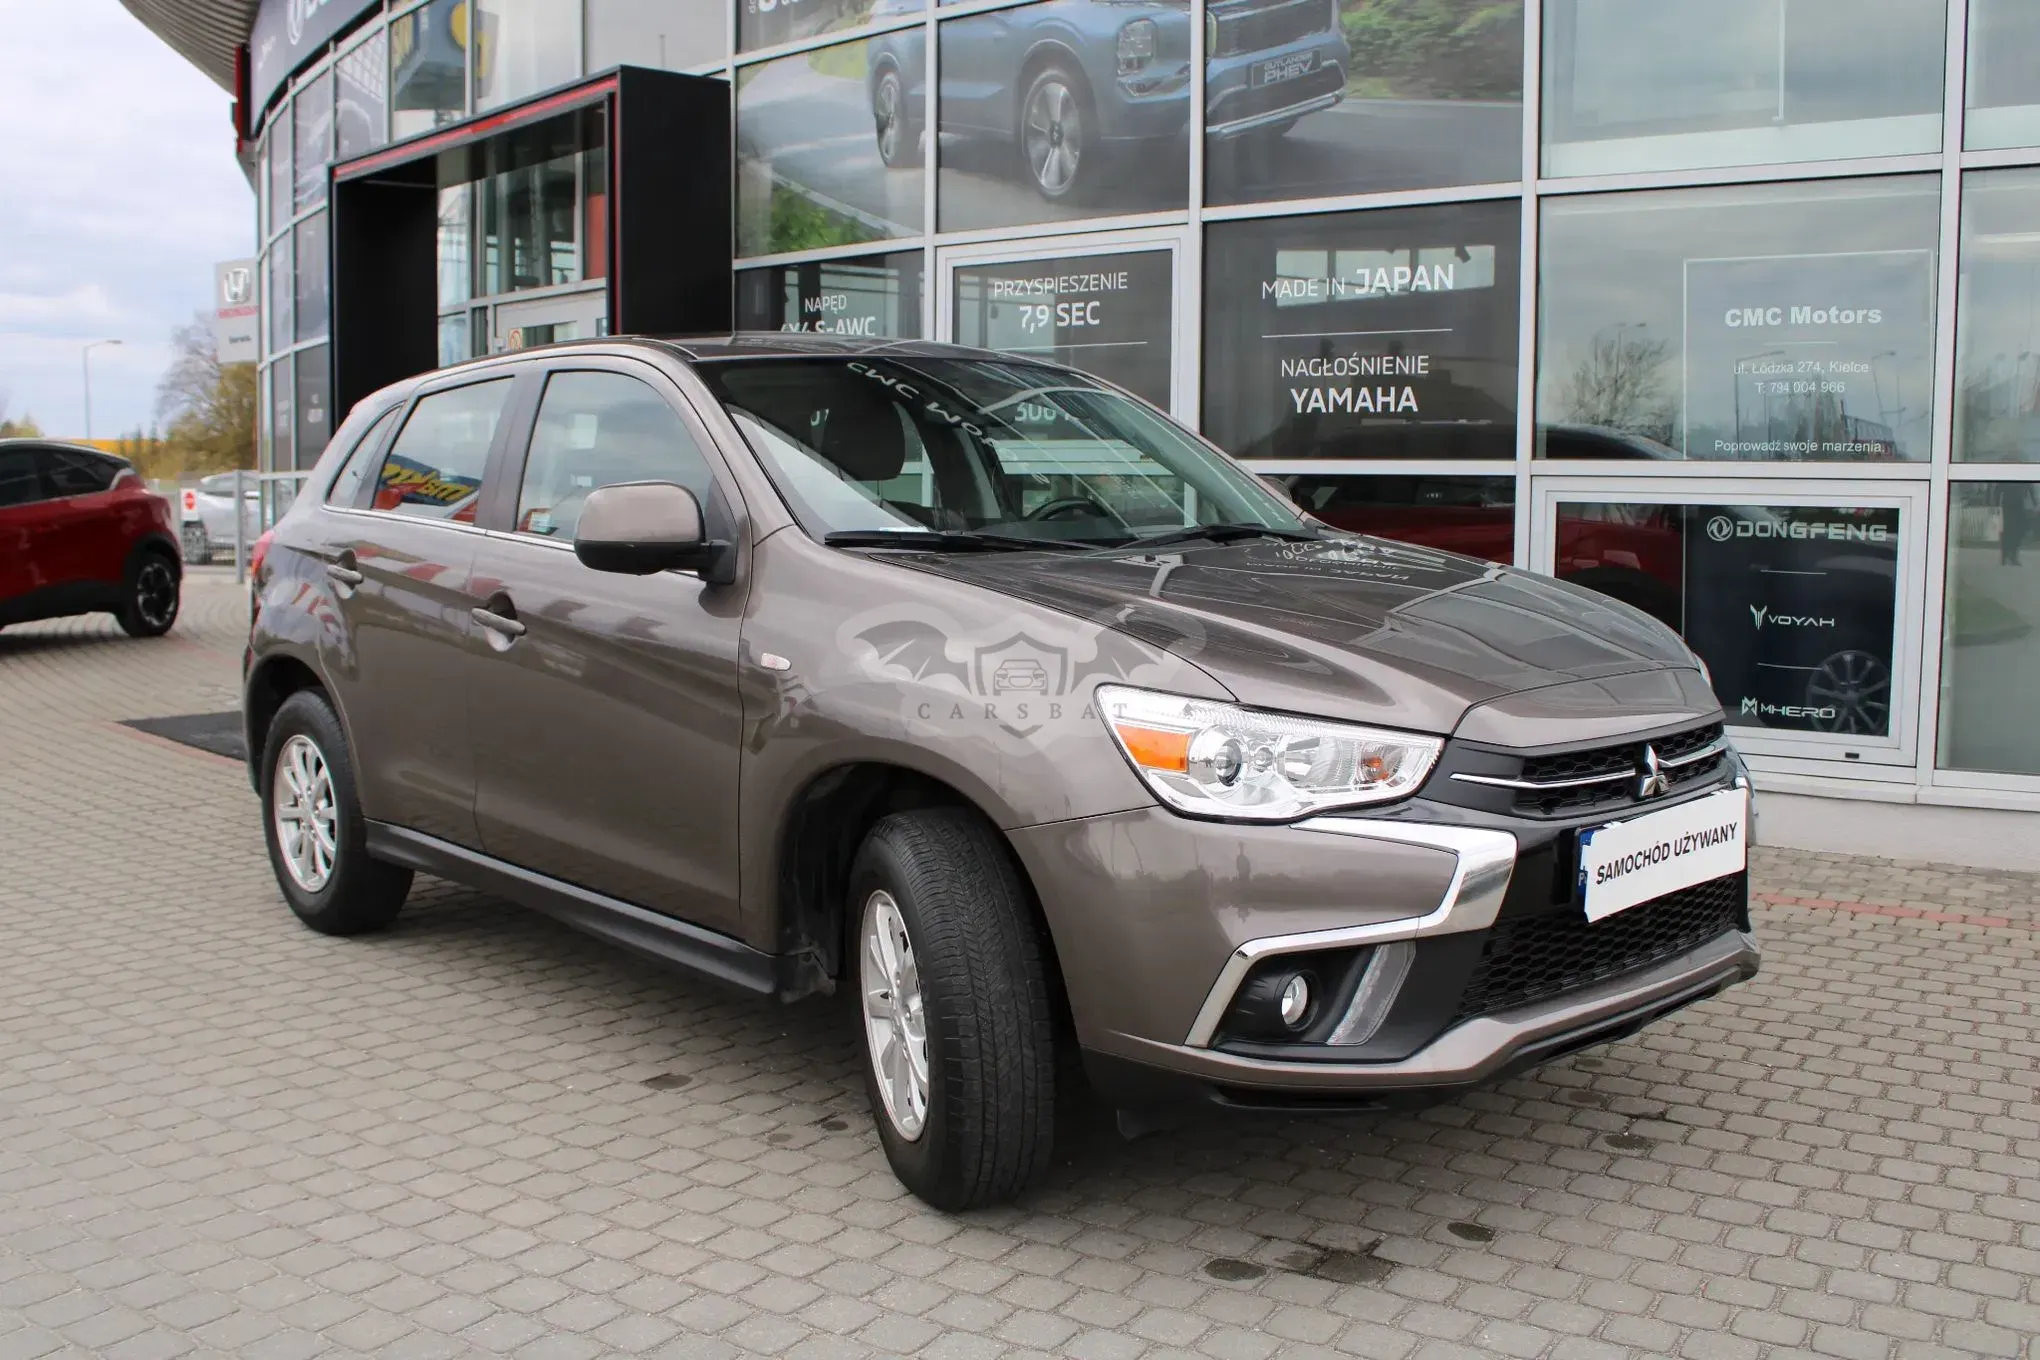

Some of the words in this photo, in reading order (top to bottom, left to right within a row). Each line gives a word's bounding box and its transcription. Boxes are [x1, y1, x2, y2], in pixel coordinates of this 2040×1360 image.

[1263, 60, 1313, 84] PHEV
[994, 271, 1128, 297] PRZYSPIESZENIE
[1262, 279, 1318, 300] MADE
[1326, 277, 1345, 295] IN
[1355, 263, 1454, 295] JAPAN
[804, 295, 847, 314] NAPĘD
[1019, 304, 1050, 334] 7,9
[1056, 301, 1100, 327] SEC
[1724, 307, 1782, 327] CMC
[1790, 305, 1882, 325] Motors
[1281, 352, 1429, 377] NAGŁOŚNIENIE
[1829, 360, 1869, 374] Kielce
[1793, 381, 1817, 393] 004
[1821, 381, 1846, 393] 966
[1290, 386, 1419, 413] YAMAHA
[1714, 440, 1781, 454] Poprowadź
[1783, 440, 1818, 454] swoje
[1736, 520, 1888, 542] DONGFENG
[1768, 614, 1835, 628] VOYAH
[1760, 703, 1836, 719] MHERO
[1596, 840, 1670, 885] SAMOCHÓD
[1674, 822, 1738, 857] UŻYWANY
